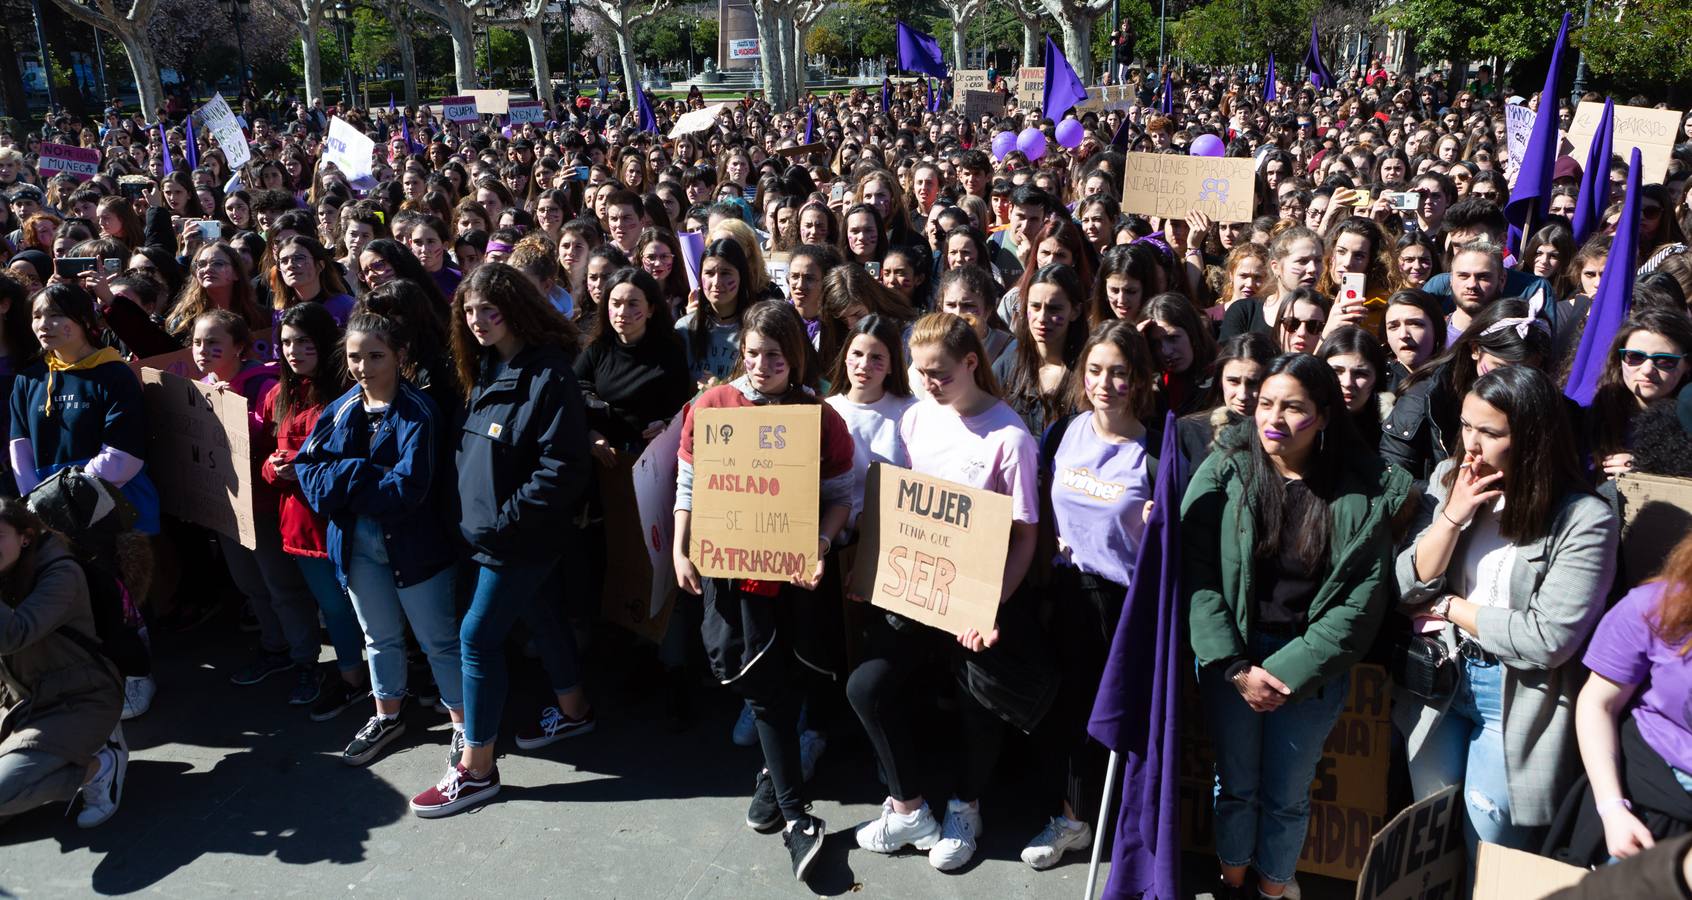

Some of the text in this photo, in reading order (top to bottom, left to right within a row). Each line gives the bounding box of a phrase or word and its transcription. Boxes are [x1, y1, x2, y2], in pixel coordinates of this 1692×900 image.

[448, 106, 474, 118] GUAPA
[511, 108, 539, 121] NENA
[759, 425, 787, 449] ES
[722, 457, 773, 469] UN CASO
[708, 474, 780, 496] AISLADO
[1063, 467, 1124, 501] winner
[897, 478, 973, 529] MUJER
[726, 510, 790, 533] SE LLAMA
[930, 532, 952, 548] QUE
[700, 539, 806, 575] PATRIARCADO
[882, 545, 956, 616] SER
